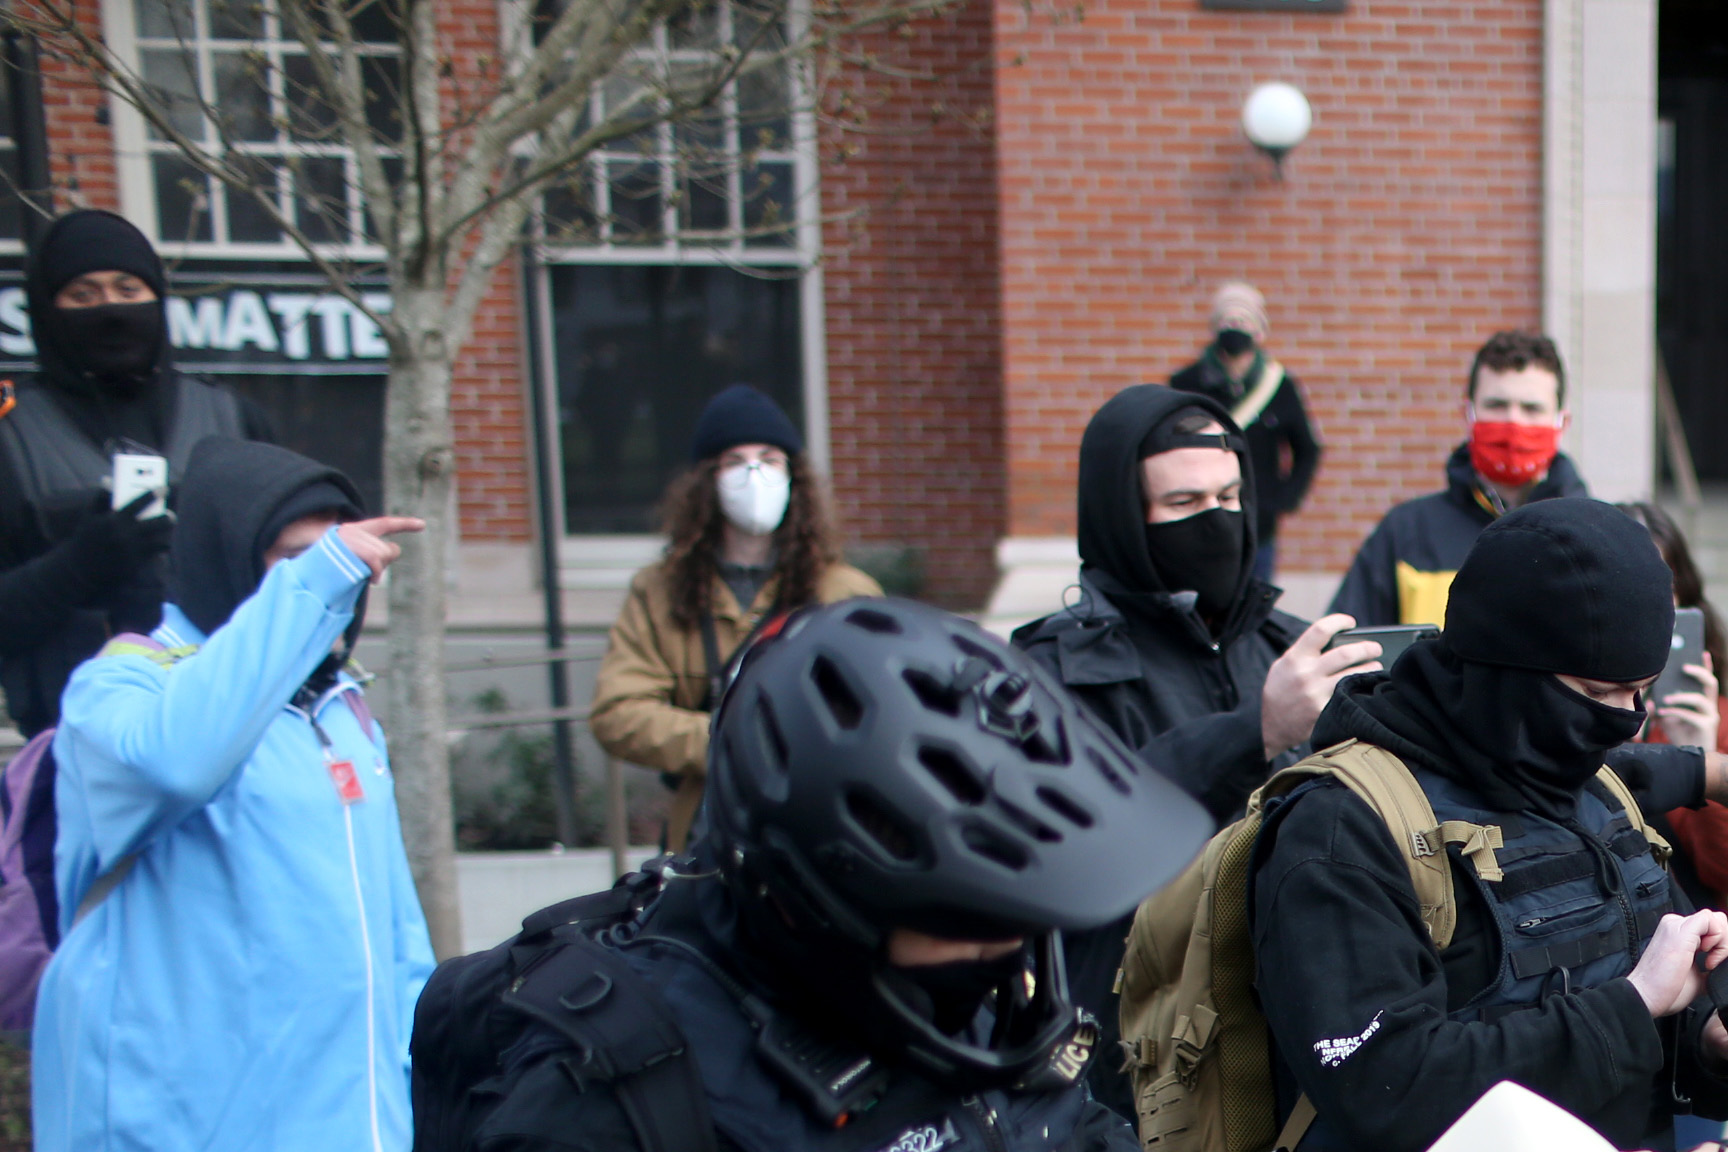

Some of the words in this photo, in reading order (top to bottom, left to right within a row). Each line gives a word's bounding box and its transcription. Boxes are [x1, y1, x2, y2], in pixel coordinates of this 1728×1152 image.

[167, 289, 391, 360] MATTE
[1055, 1026, 1096, 1081] LICE
[1360, 1020, 1380, 1041] 2019
